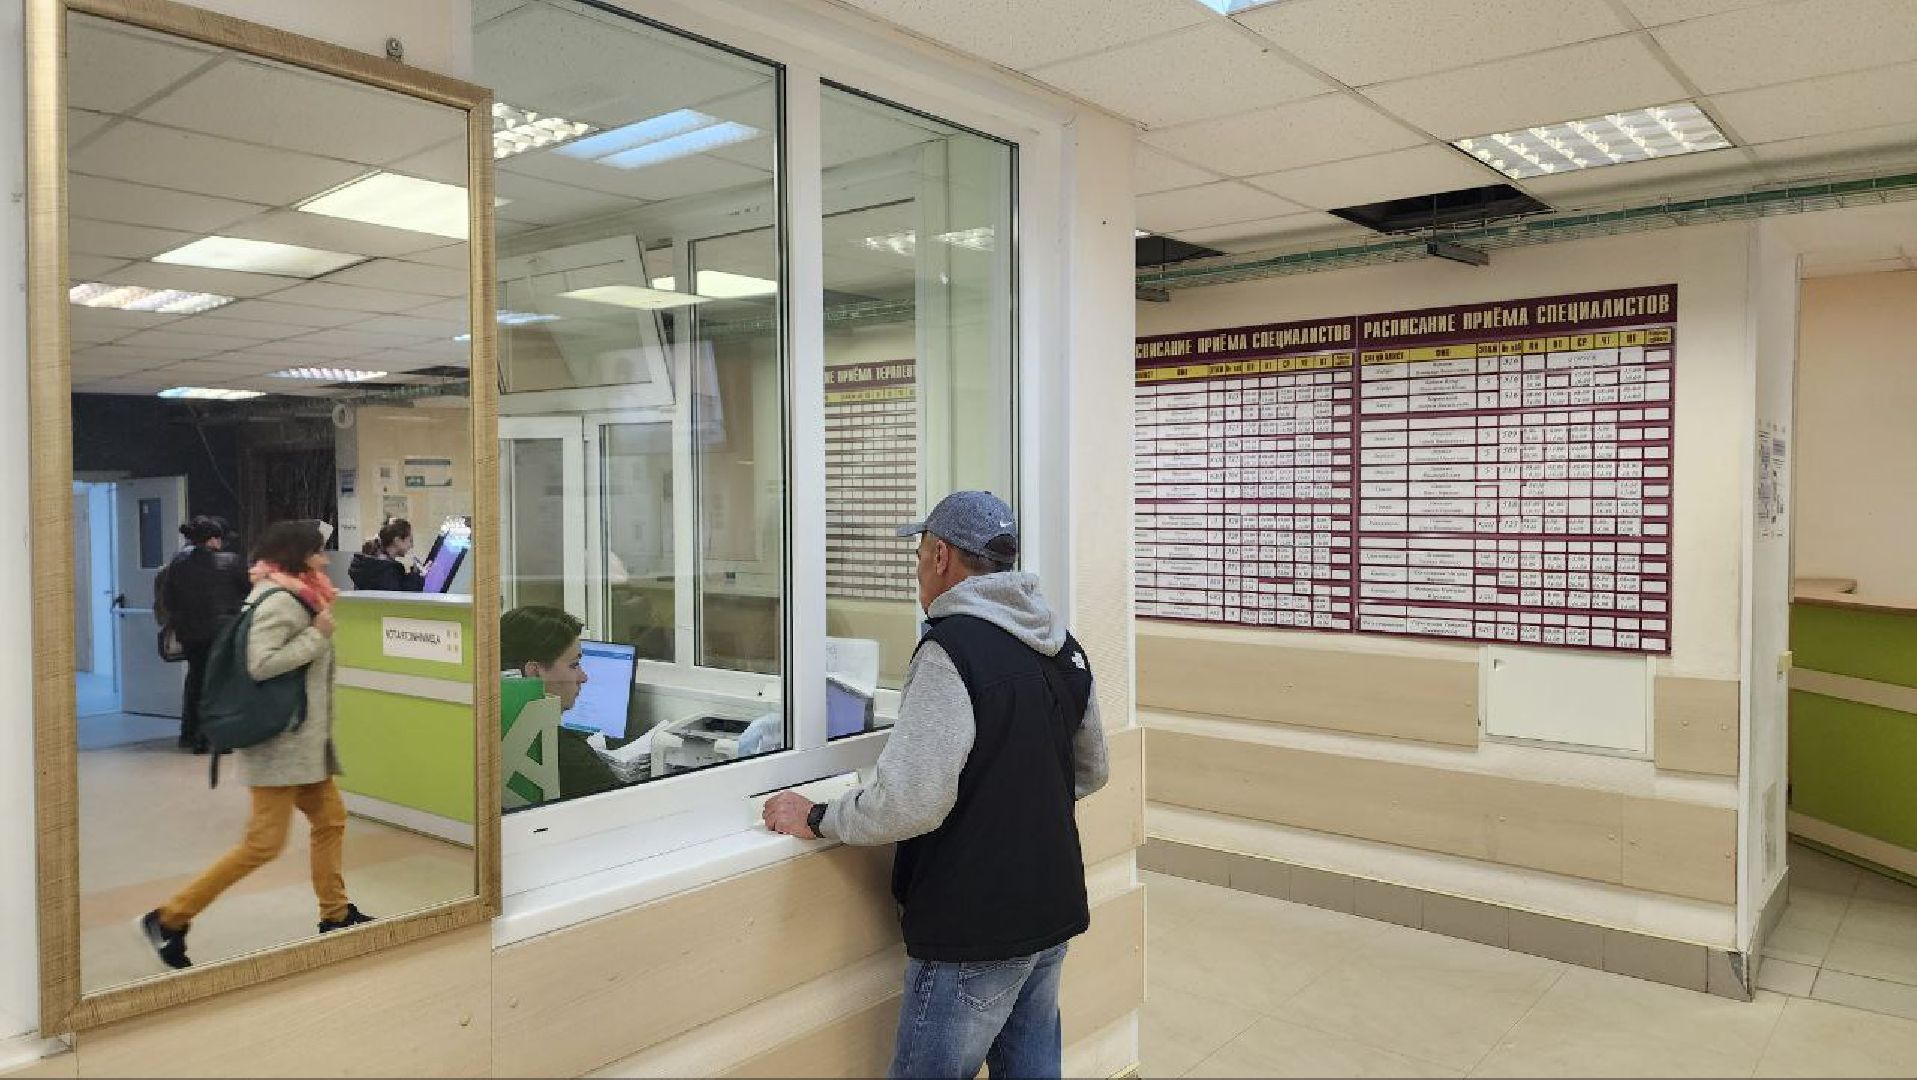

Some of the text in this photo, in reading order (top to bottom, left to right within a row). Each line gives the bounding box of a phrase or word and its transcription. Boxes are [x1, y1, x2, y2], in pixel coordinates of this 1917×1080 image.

[1363, 294, 1670, 339] РАСПИСАНИЕ ПРИЁМА СПЕЦИАЛИСТОВ
[1197, 333, 1247, 354] ПРИЁМА
[1252, 324, 1351, 349] СПЕЦИАЛИСТОВ
